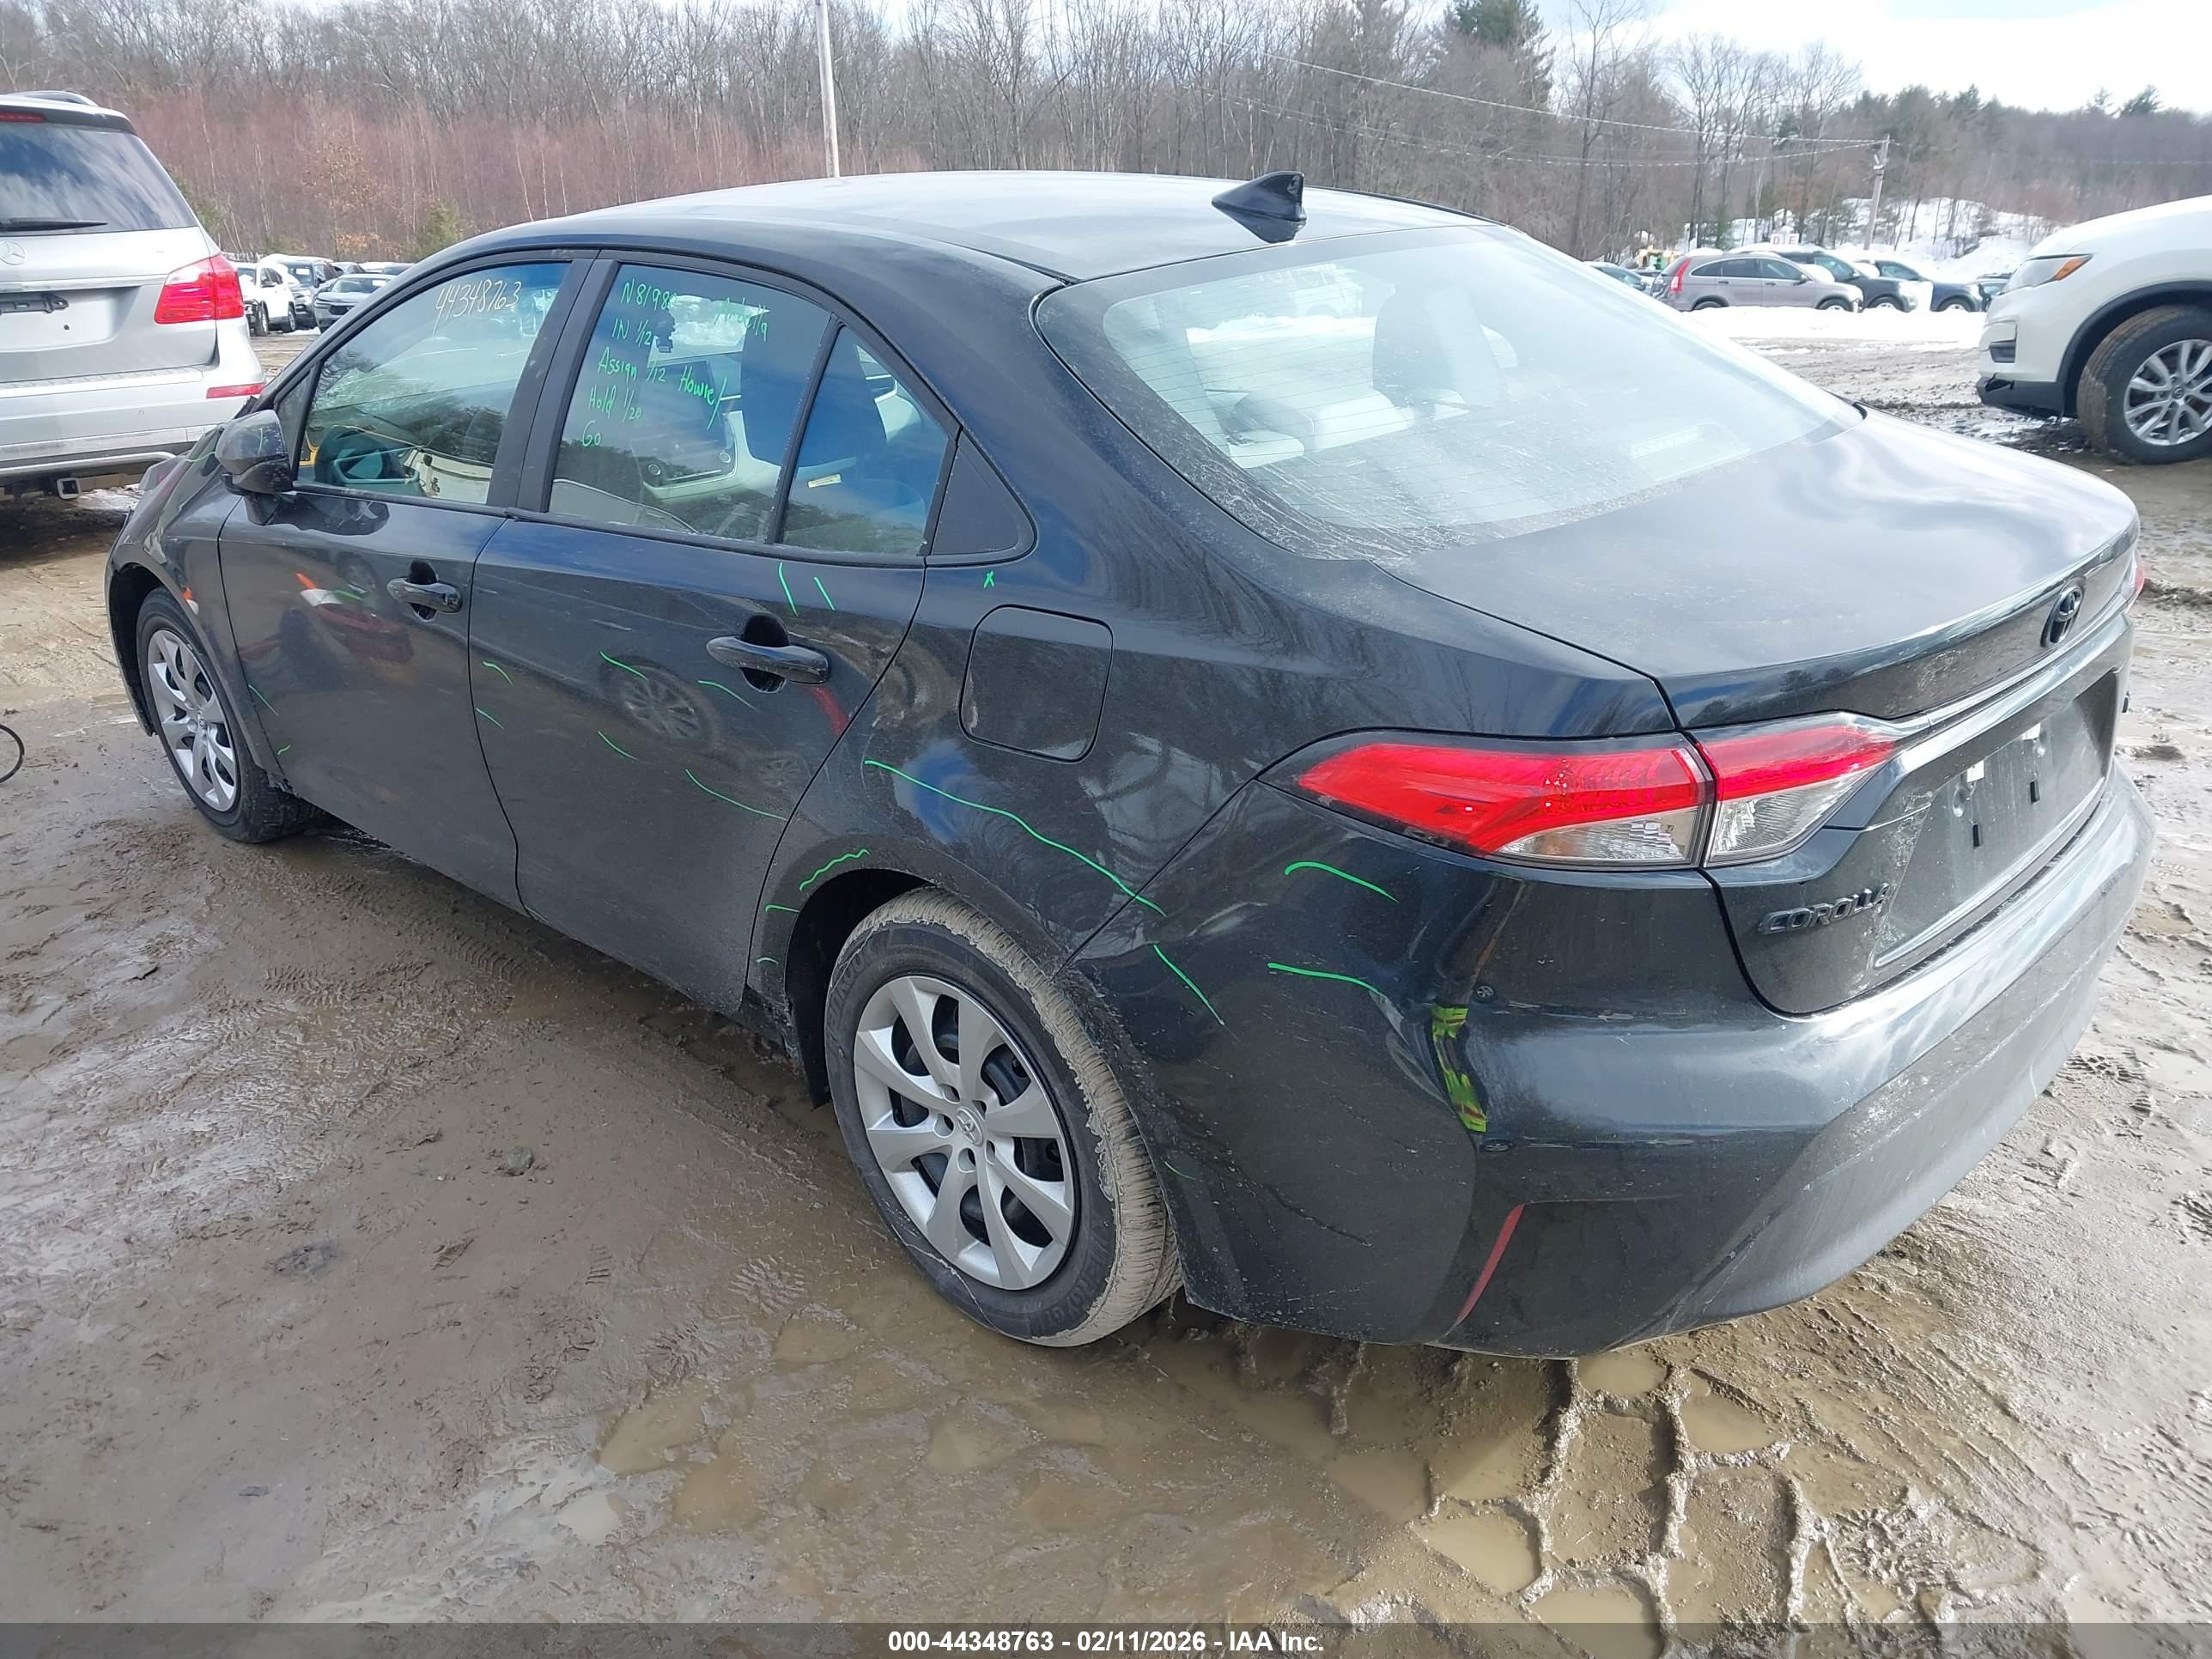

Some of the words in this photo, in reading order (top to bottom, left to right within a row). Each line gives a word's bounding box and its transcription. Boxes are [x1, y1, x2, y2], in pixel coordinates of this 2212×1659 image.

[432, 278, 522, 337] 44348763
[597, 345, 638, 385] Assign
[587, 383, 617, 420] Hold
[1758, 882, 1890, 935] COROLLA
